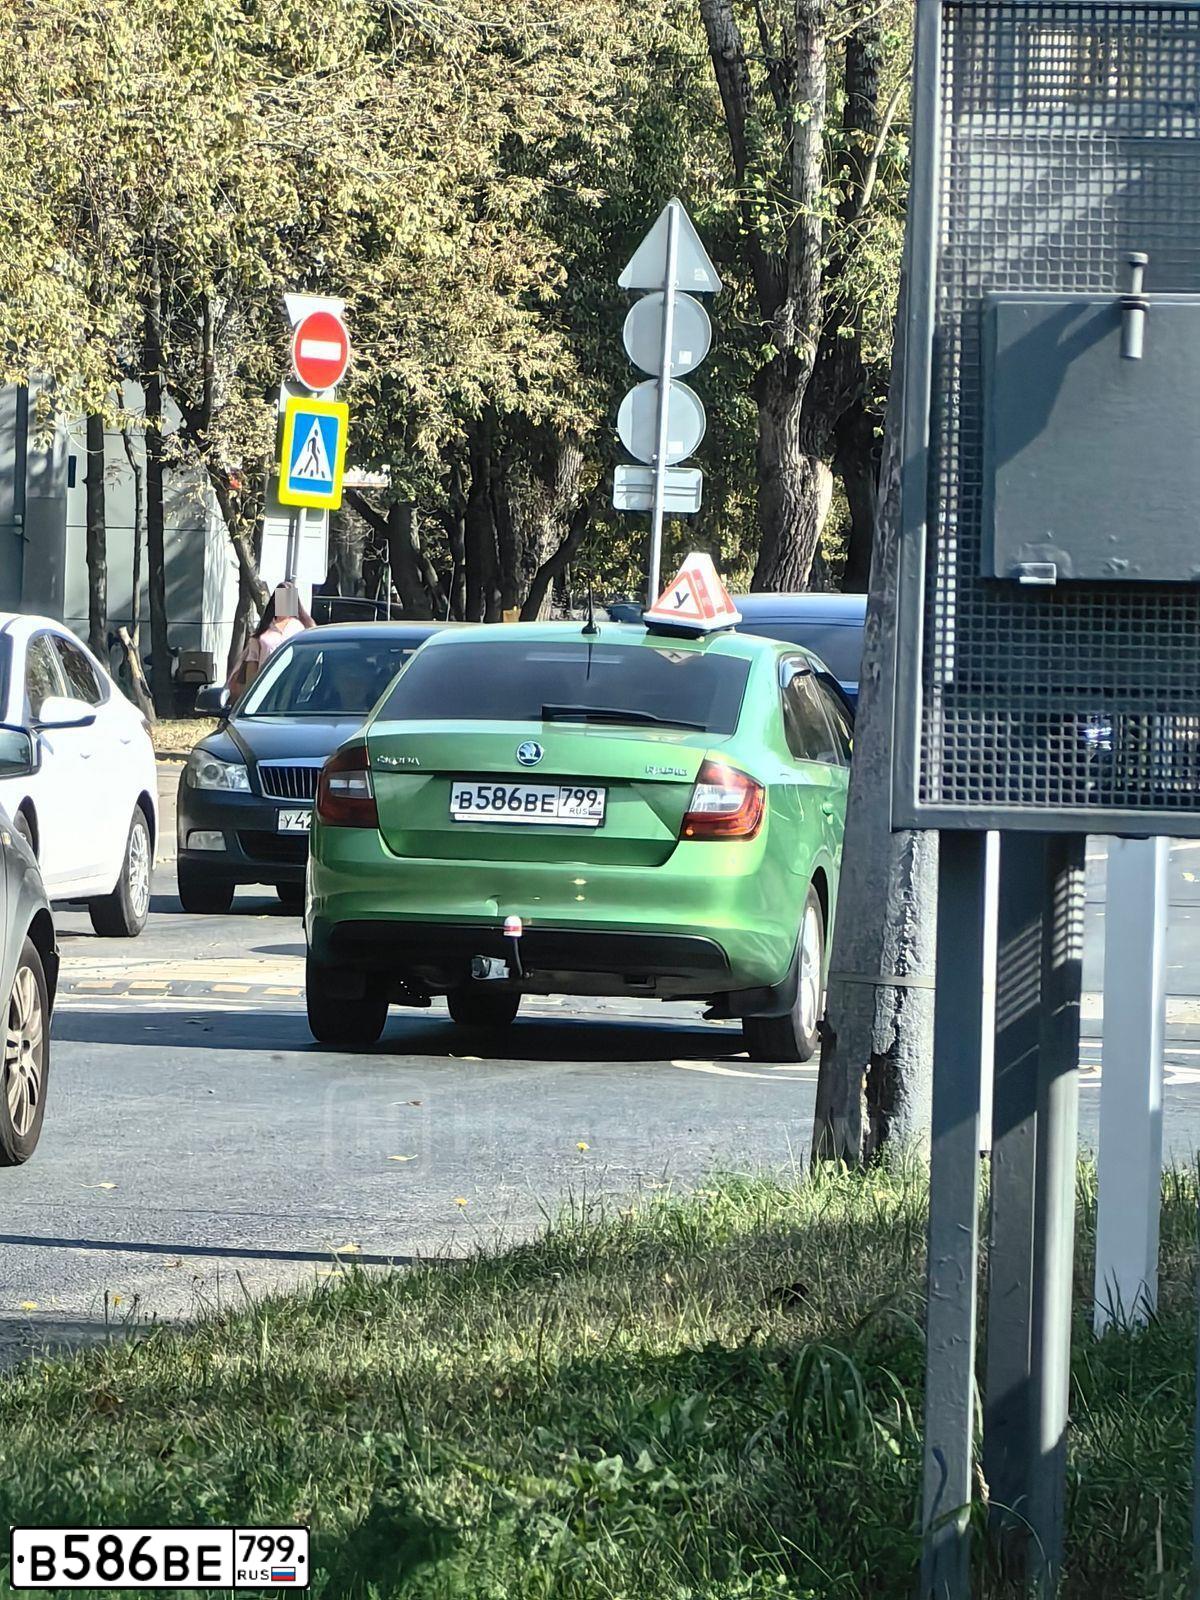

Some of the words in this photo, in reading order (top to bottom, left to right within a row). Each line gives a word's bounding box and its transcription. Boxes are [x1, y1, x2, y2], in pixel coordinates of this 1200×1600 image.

[674, 592, 690, 609] У
[459, 786, 556, 813] В586ВЕ
[561, 788, 598, 808] 799
